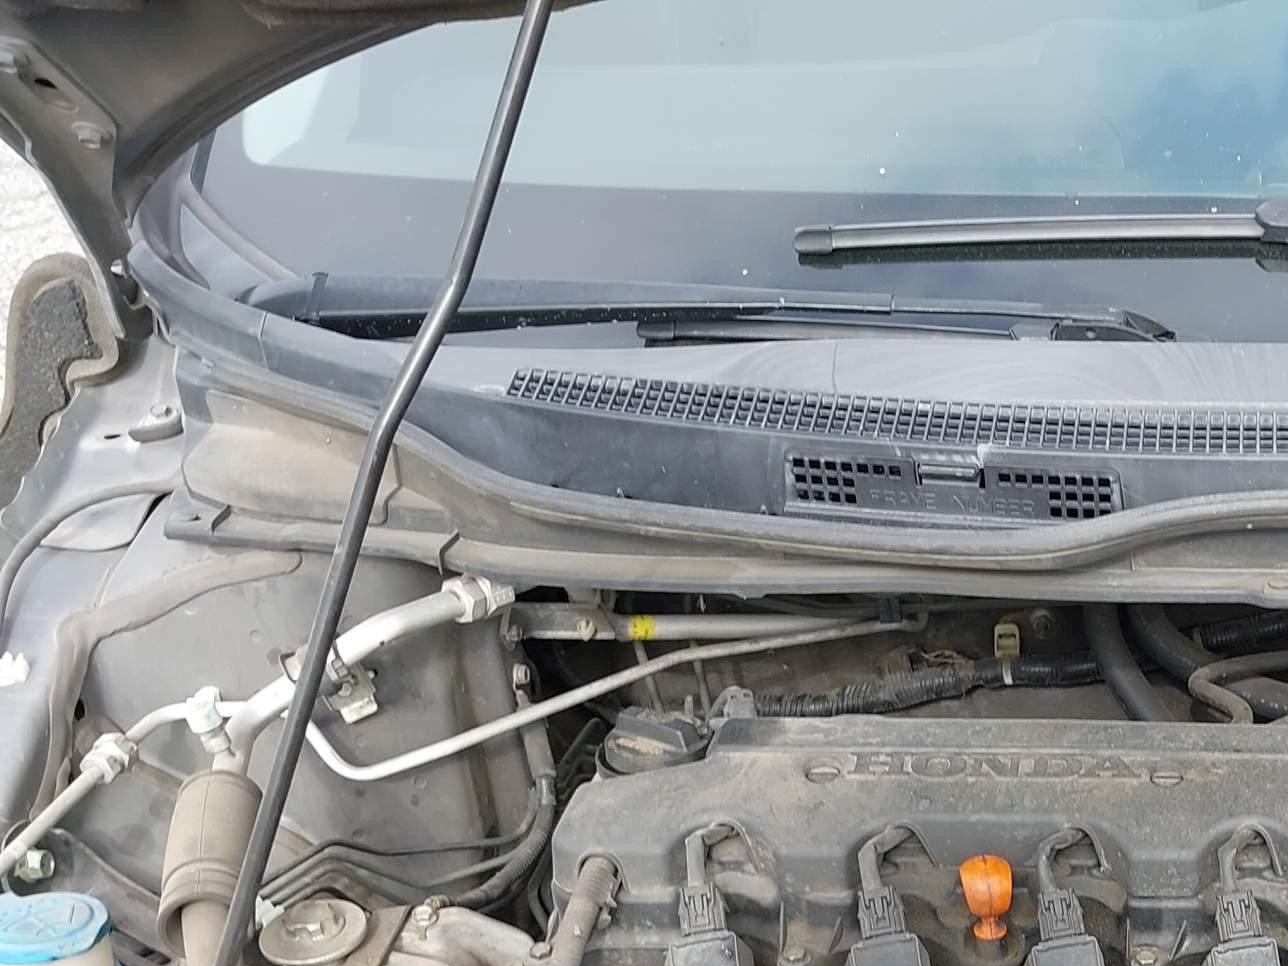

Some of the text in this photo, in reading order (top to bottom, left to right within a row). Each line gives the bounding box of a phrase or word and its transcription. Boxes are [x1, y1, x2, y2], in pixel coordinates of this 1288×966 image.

[869, 489, 1035, 514] FRAME NUMBER
[849, 751, 1142, 779] HONDA
